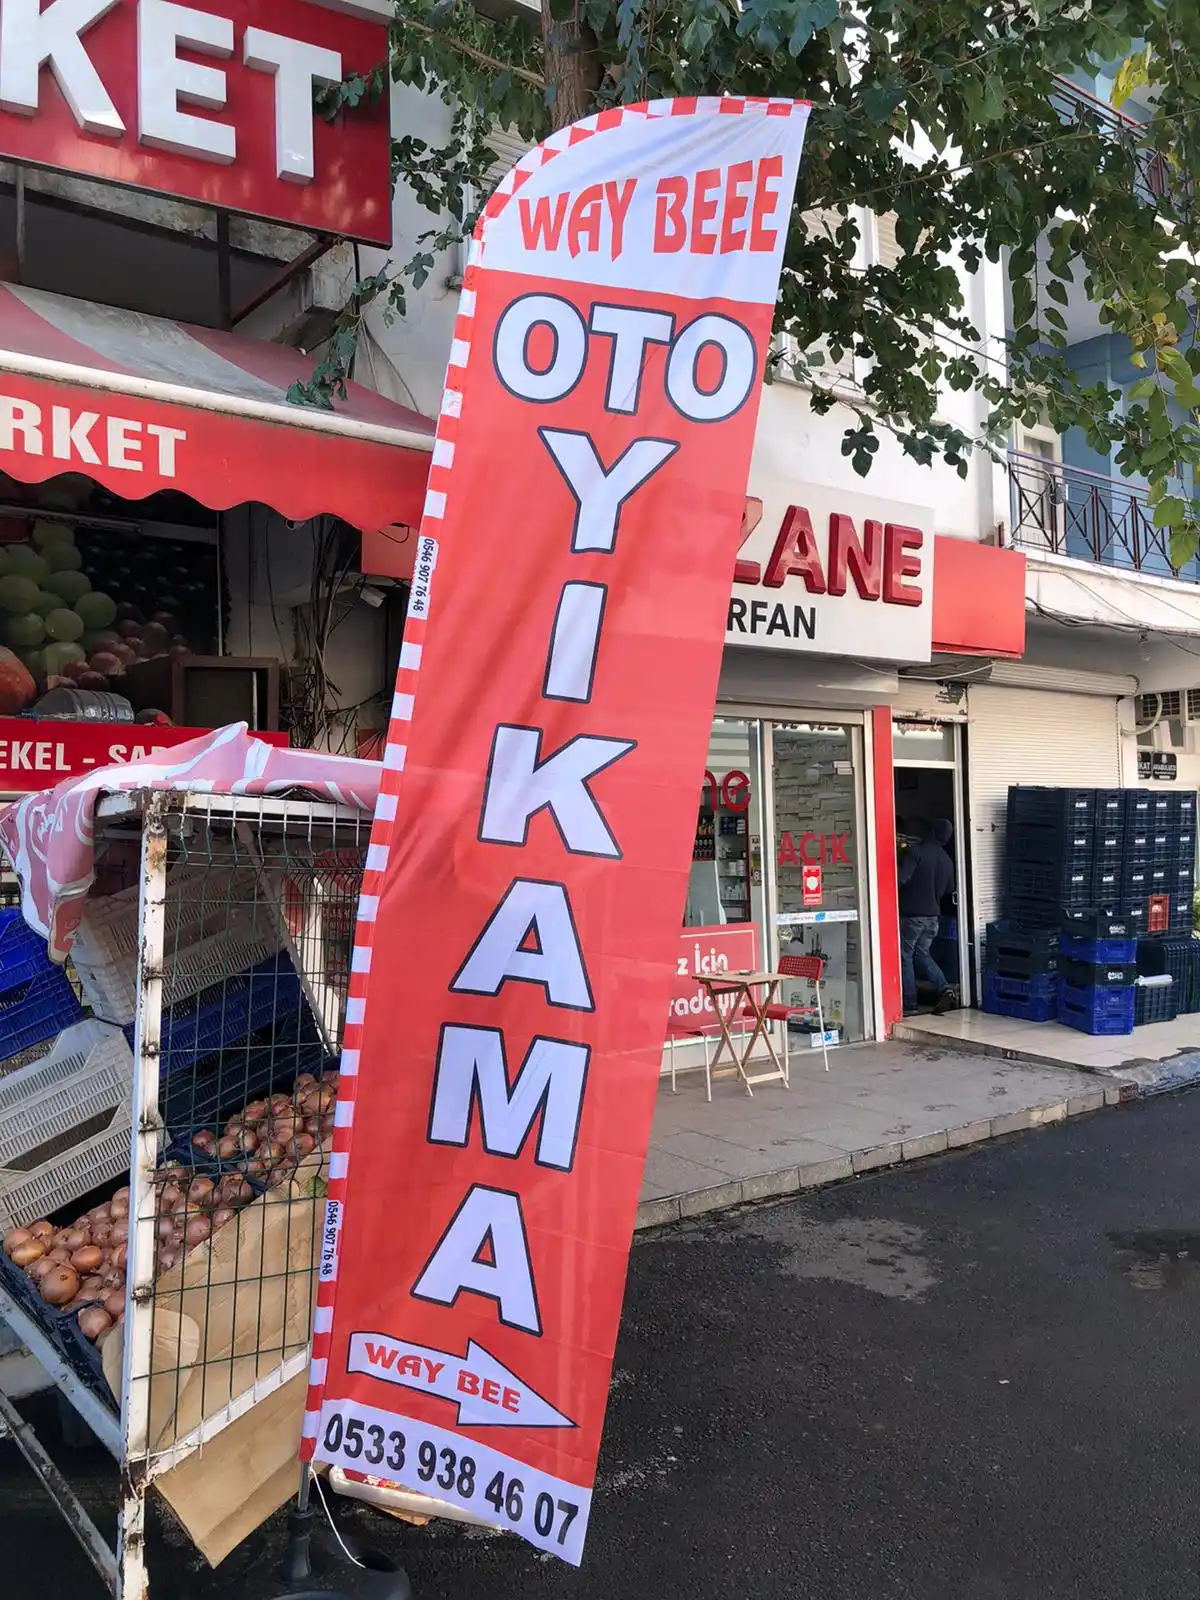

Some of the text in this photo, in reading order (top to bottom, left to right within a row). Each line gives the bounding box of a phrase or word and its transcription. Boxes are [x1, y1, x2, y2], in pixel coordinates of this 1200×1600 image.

[0, 0, 342, 185] KET
[517, 155, 783, 262] WAY BEEE
[492, 292, 758, 423] OTO
[0, 394, 187, 478] RKET
[413, 538, 434, 612] 0546 907 76 48
[411, 425, 681, 1337] YIKAMA
[322, 1201, 338, 1275] 0546 907 76 48
[365, 1342, 521, 1413] WAY BEE
[323, 1413, 579, 1545] 0533 938 46 07
